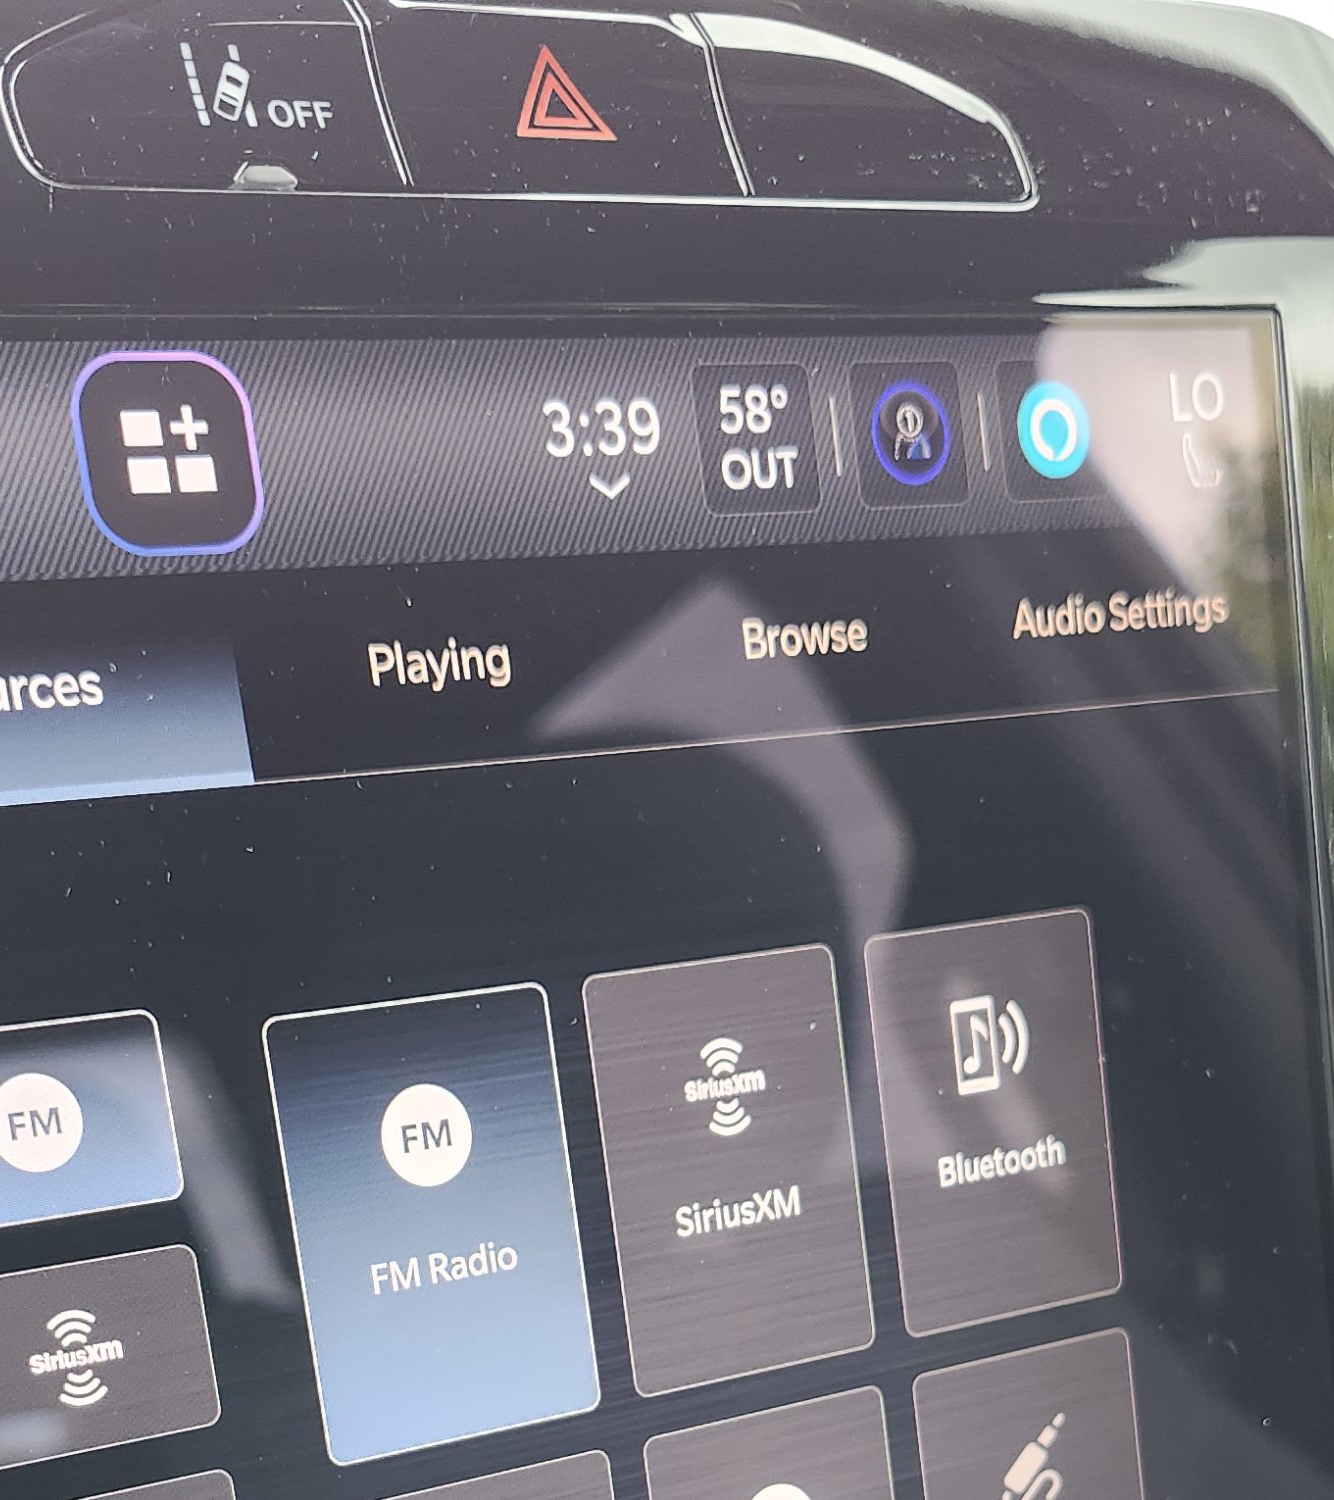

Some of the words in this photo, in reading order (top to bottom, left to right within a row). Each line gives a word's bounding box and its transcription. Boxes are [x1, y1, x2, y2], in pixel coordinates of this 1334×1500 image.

[268, 99, 334, 131] OFF
[1170, 370, 1224, 423] LO
[542, 397, 661, 458] 3:39
[721, 445, 798, 491] OUT
[1013, 592, 1105, 639] Audio
[1108, 584, 1229, 634] Settings
[368, 636, 512, 692] Playing
[742, 617, 868, 661] Browse
[6, 1106, 64, 1143] FM
[399, 1117, 454, 1155] FM
[938, 1133, 1067, 1188] Bluetooth
[674, 1184, 801, 1239] SiriusXM
[370, 1260, 422, 1295] FM
[428, 1240, 519, 1286] Radio
